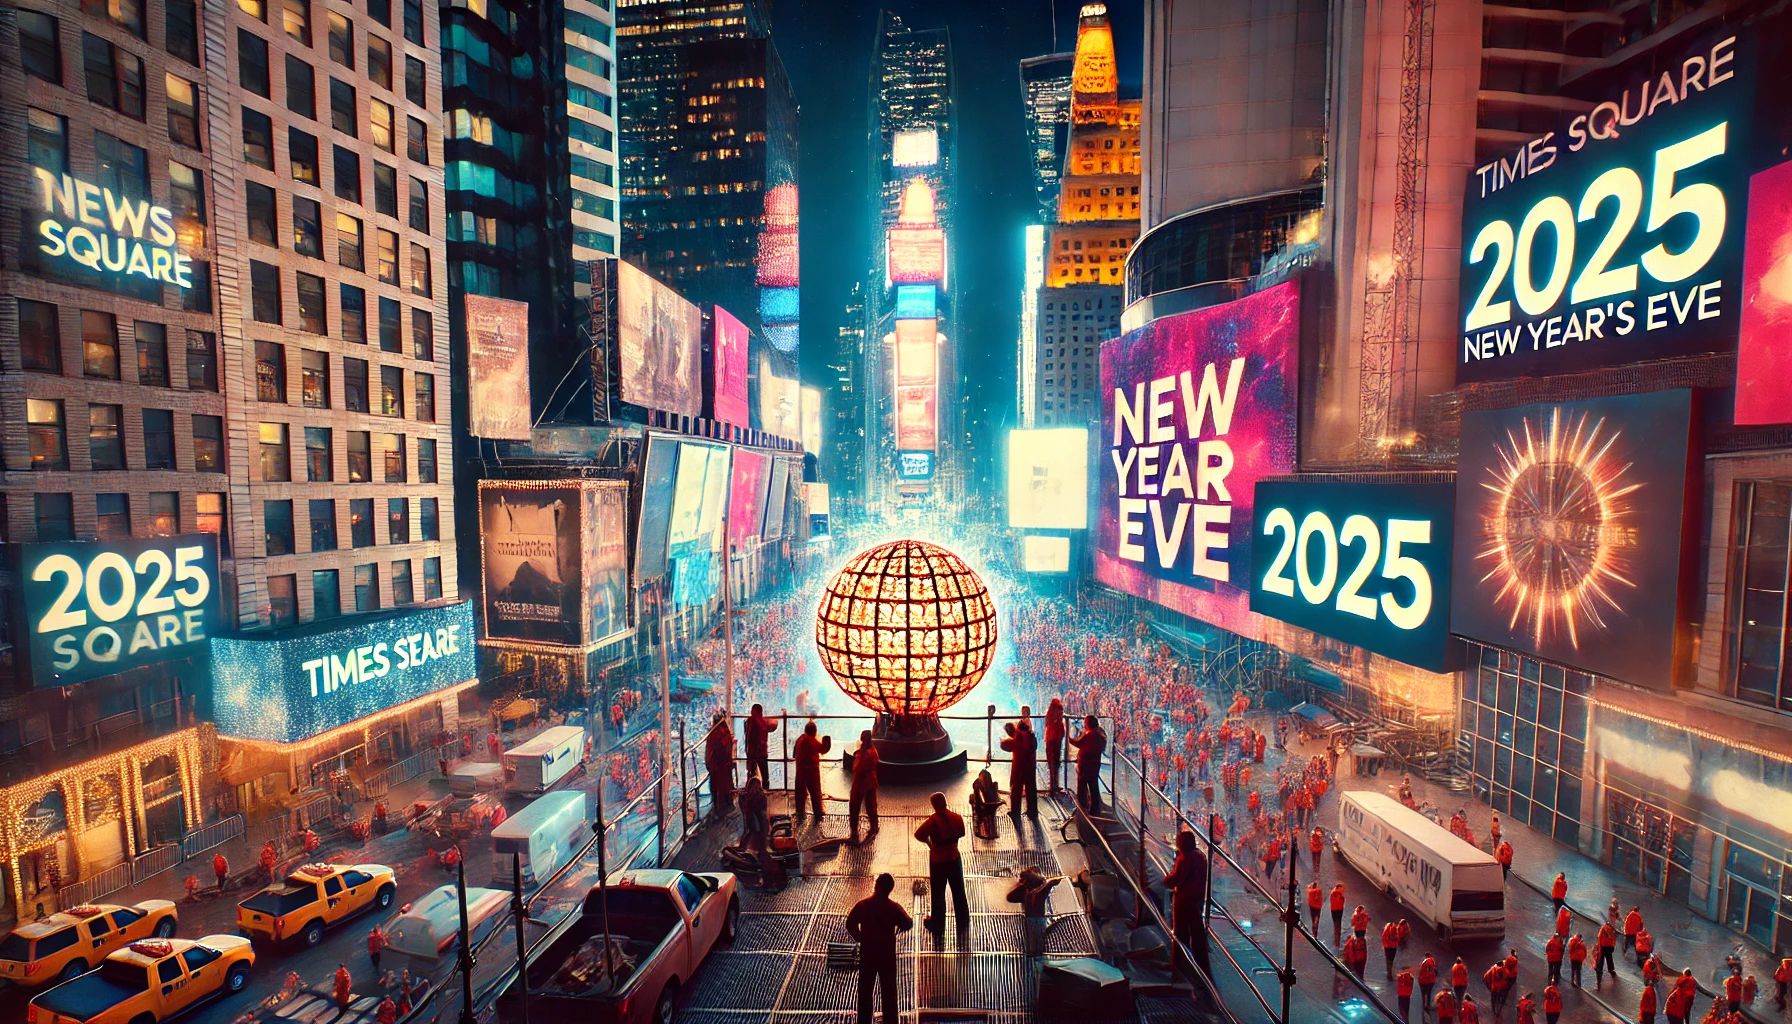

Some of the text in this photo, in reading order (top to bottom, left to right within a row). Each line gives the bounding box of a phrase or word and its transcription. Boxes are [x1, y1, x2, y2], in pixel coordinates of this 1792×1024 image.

[1476, 36, 1736, 198] TIMES SQUARE
[34, 166, 176, 247] NEWS
[1465, 120, 1728, 333] 2025
[40, 219, 192, 289] SQUARE
[1464, 280, 1722, 363] NEW YEAR'S EVE
[1113, 357, 1246, 447] NEW
[1111, 439, 1235, 502] YEAR
[1118, 497, 1232, 582] EVE
[1262, 507, 1433, 630] 2025
[32, 546, 211, 633] 2025
[302, 643, 390, 697] TIMES
